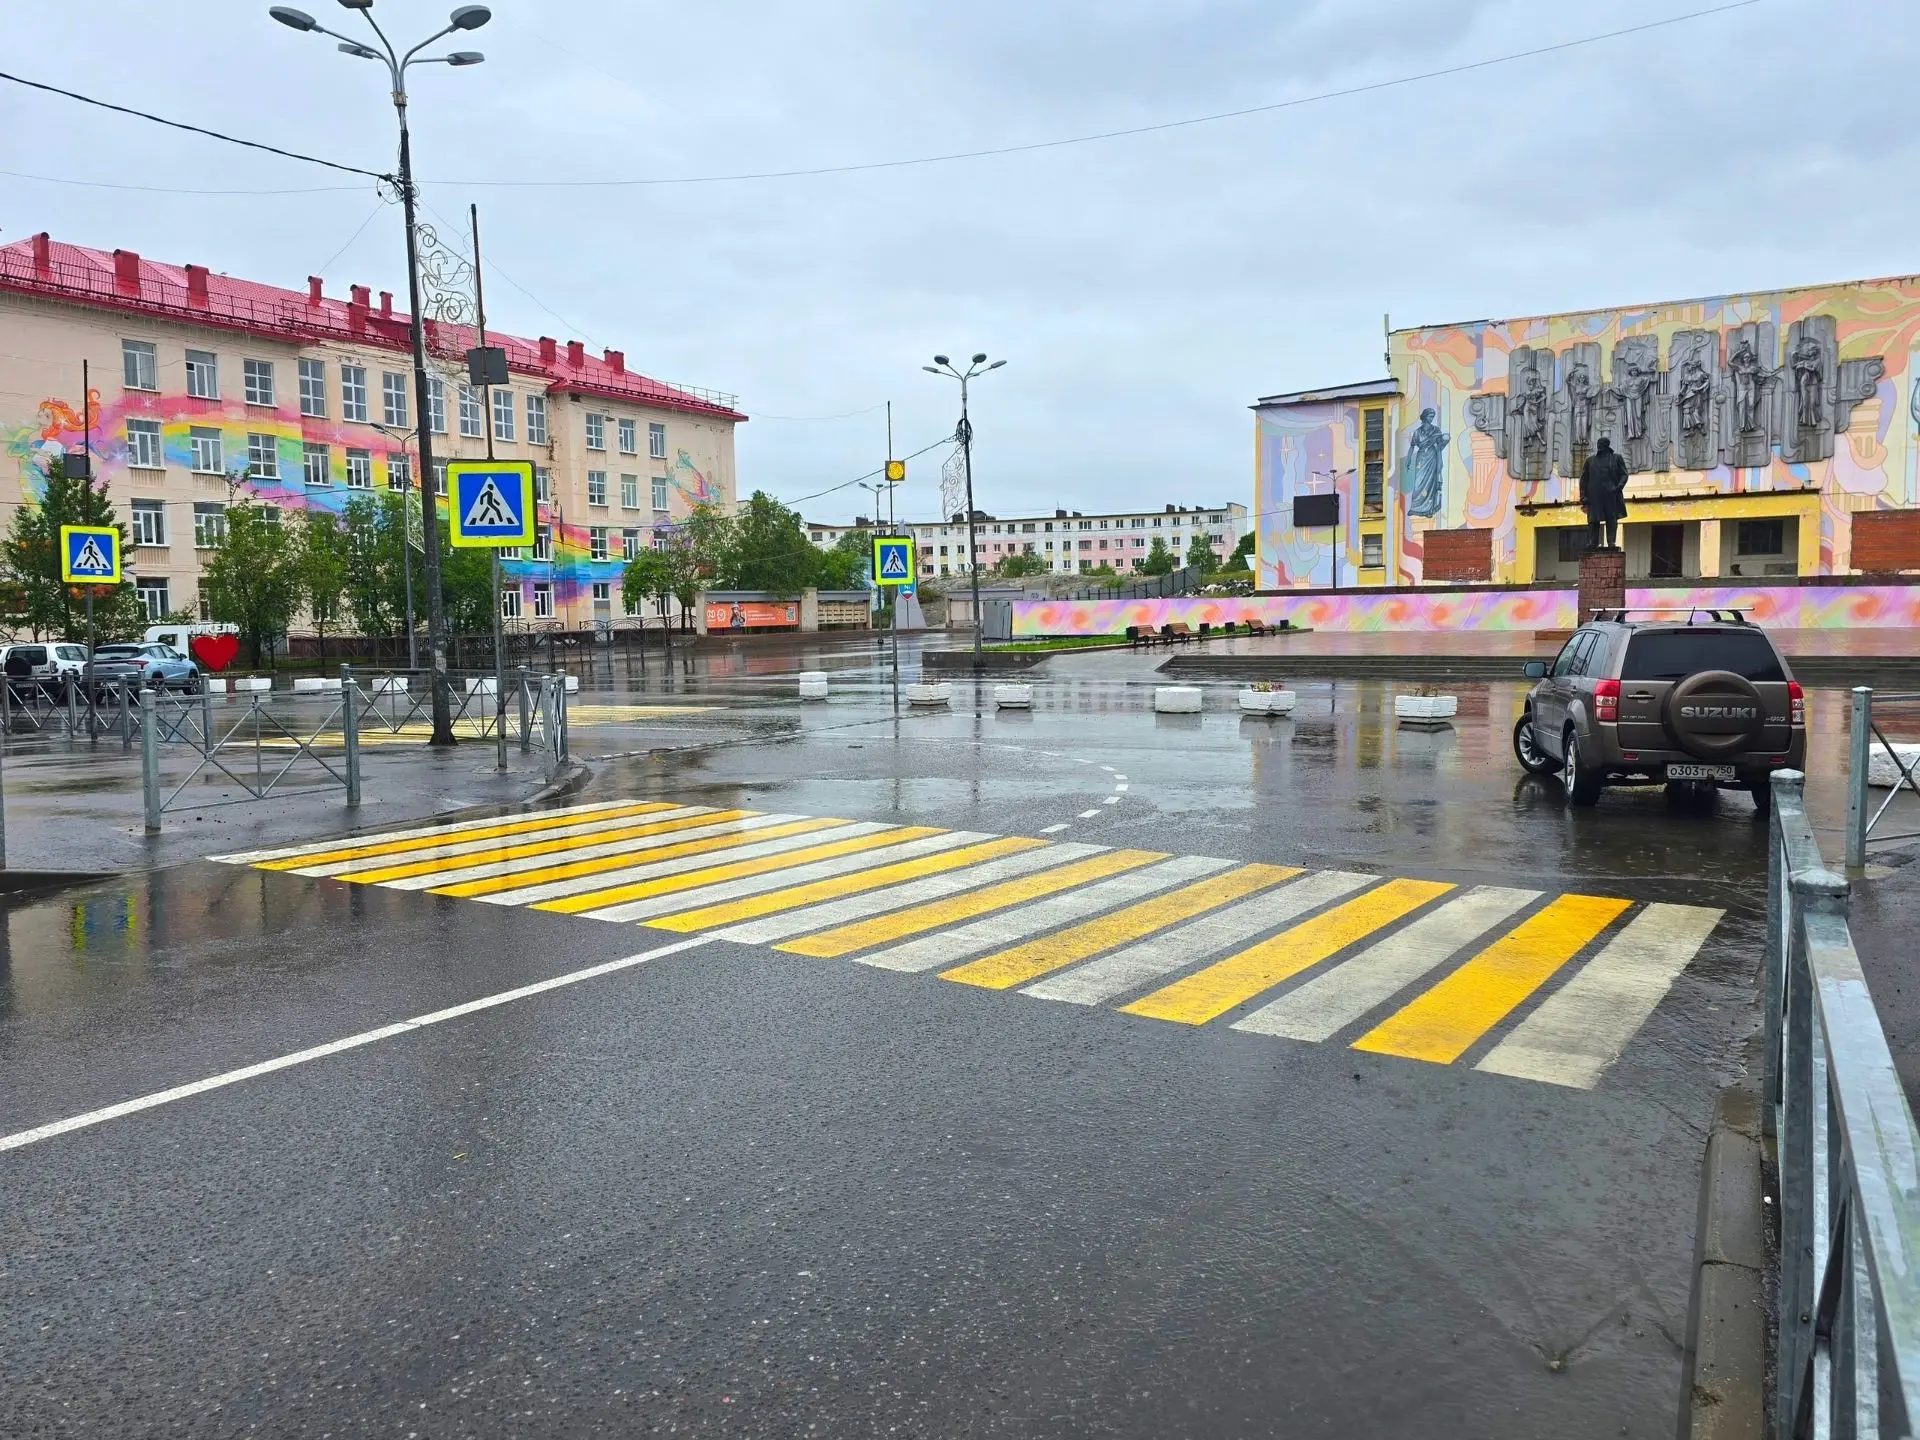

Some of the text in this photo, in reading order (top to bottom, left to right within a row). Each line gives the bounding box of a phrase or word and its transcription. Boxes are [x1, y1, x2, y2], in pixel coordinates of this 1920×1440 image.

[188, 623, 240, 634] НИКЕЛЬ
[1680, 706, 1757, 719] SUZUKI
[1716, 766, 1732, 774] 750
